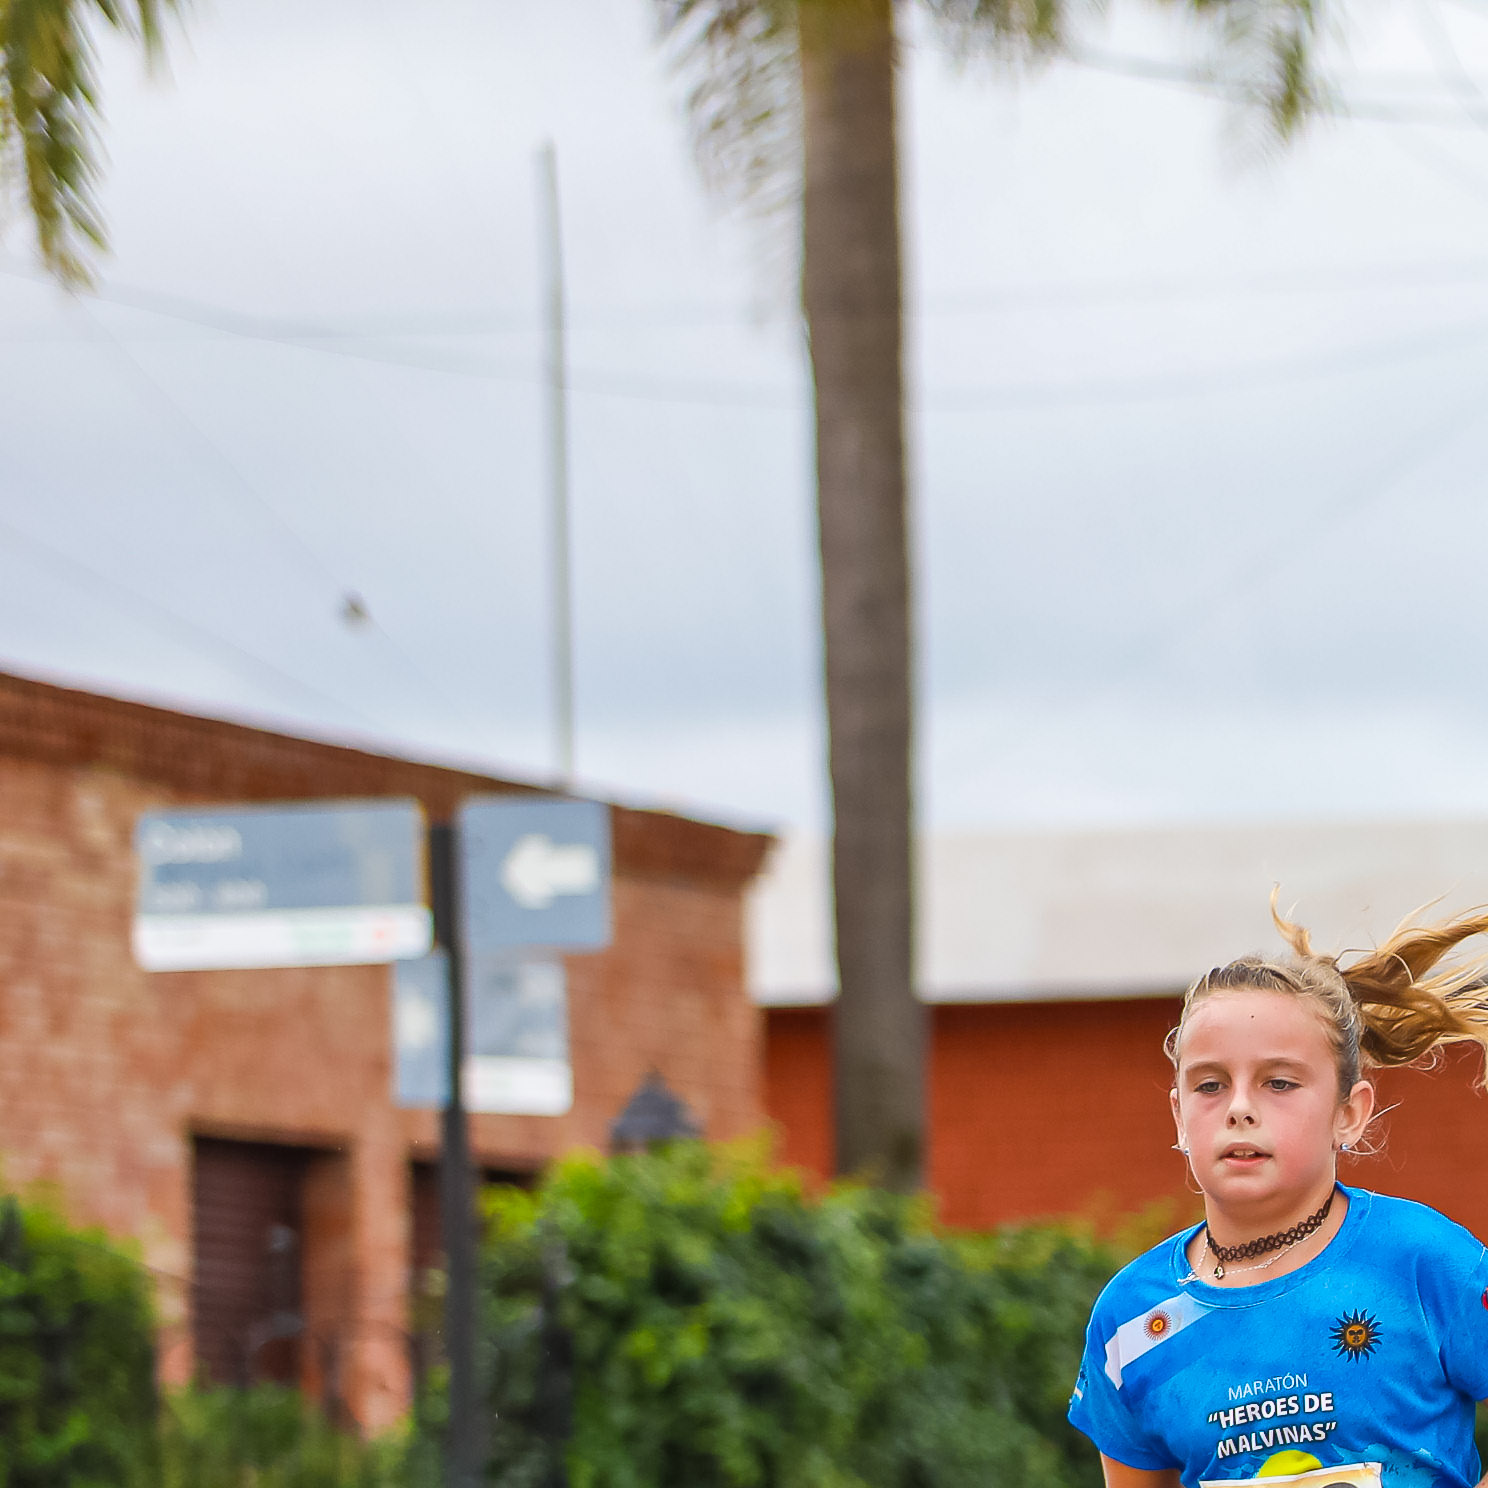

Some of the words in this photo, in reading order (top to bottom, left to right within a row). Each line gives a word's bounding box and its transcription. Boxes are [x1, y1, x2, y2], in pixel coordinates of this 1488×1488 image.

[1227, 1372, 1308, 1401] MARATÓN
[1207, 1395, 1300, 1429] “HEROES
[1303, 1392, 1334, 1414] DE
[1217, 1421, 1337, 1459] MALVINAS”
